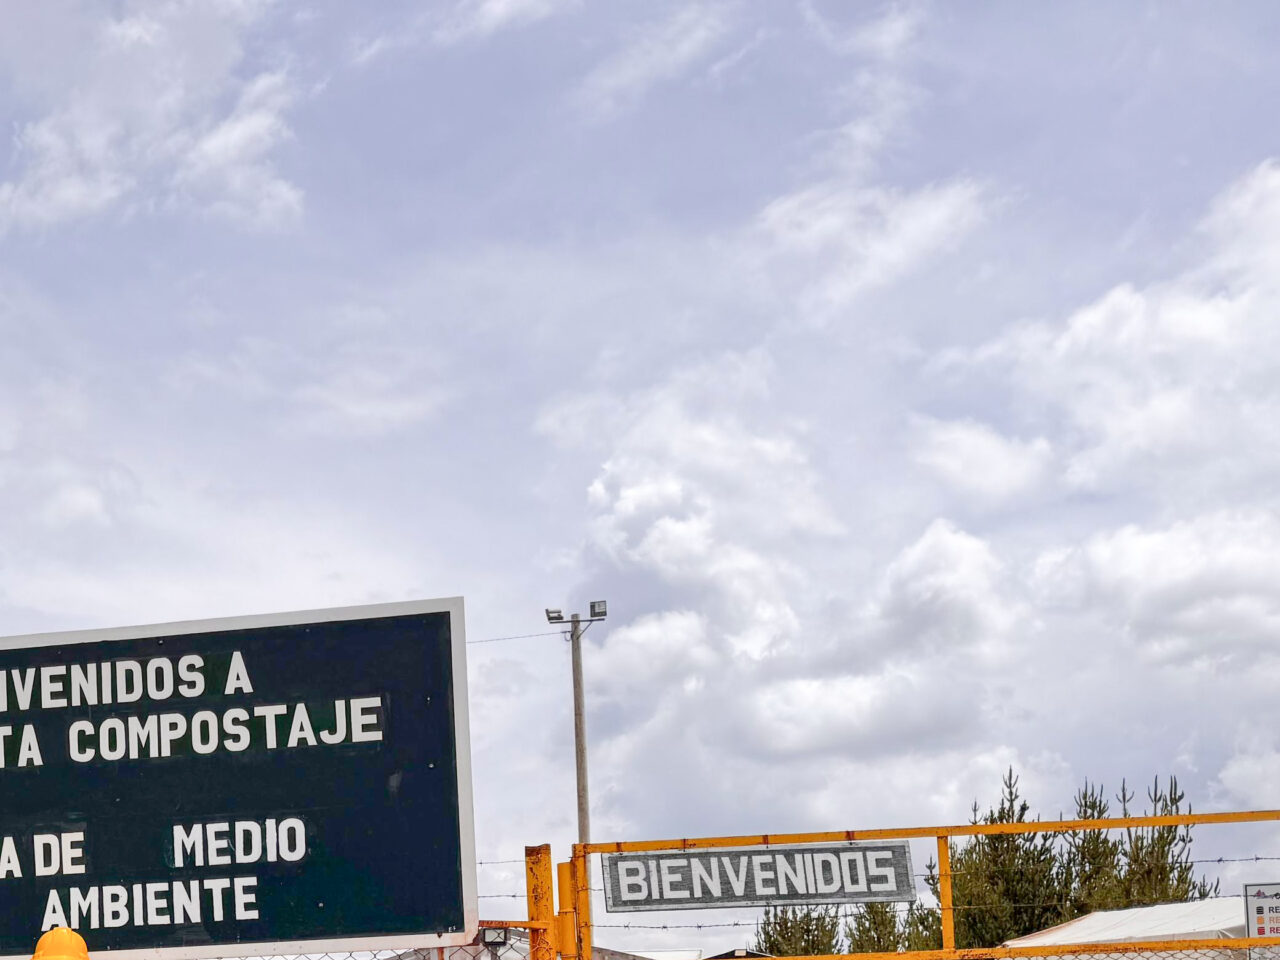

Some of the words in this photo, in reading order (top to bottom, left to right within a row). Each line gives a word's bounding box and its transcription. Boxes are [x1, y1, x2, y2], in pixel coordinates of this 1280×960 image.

[225, 651, 253, 694] A
[69, 697, 383, 763] COMPOSTAJE
[33, 832, 85, 877] DE
[173, 818, 306, 868] MEDIO
[618, 850, 897, 901] BIENVENIDOS
[41, 877, 259, 931] AMBIENTE
